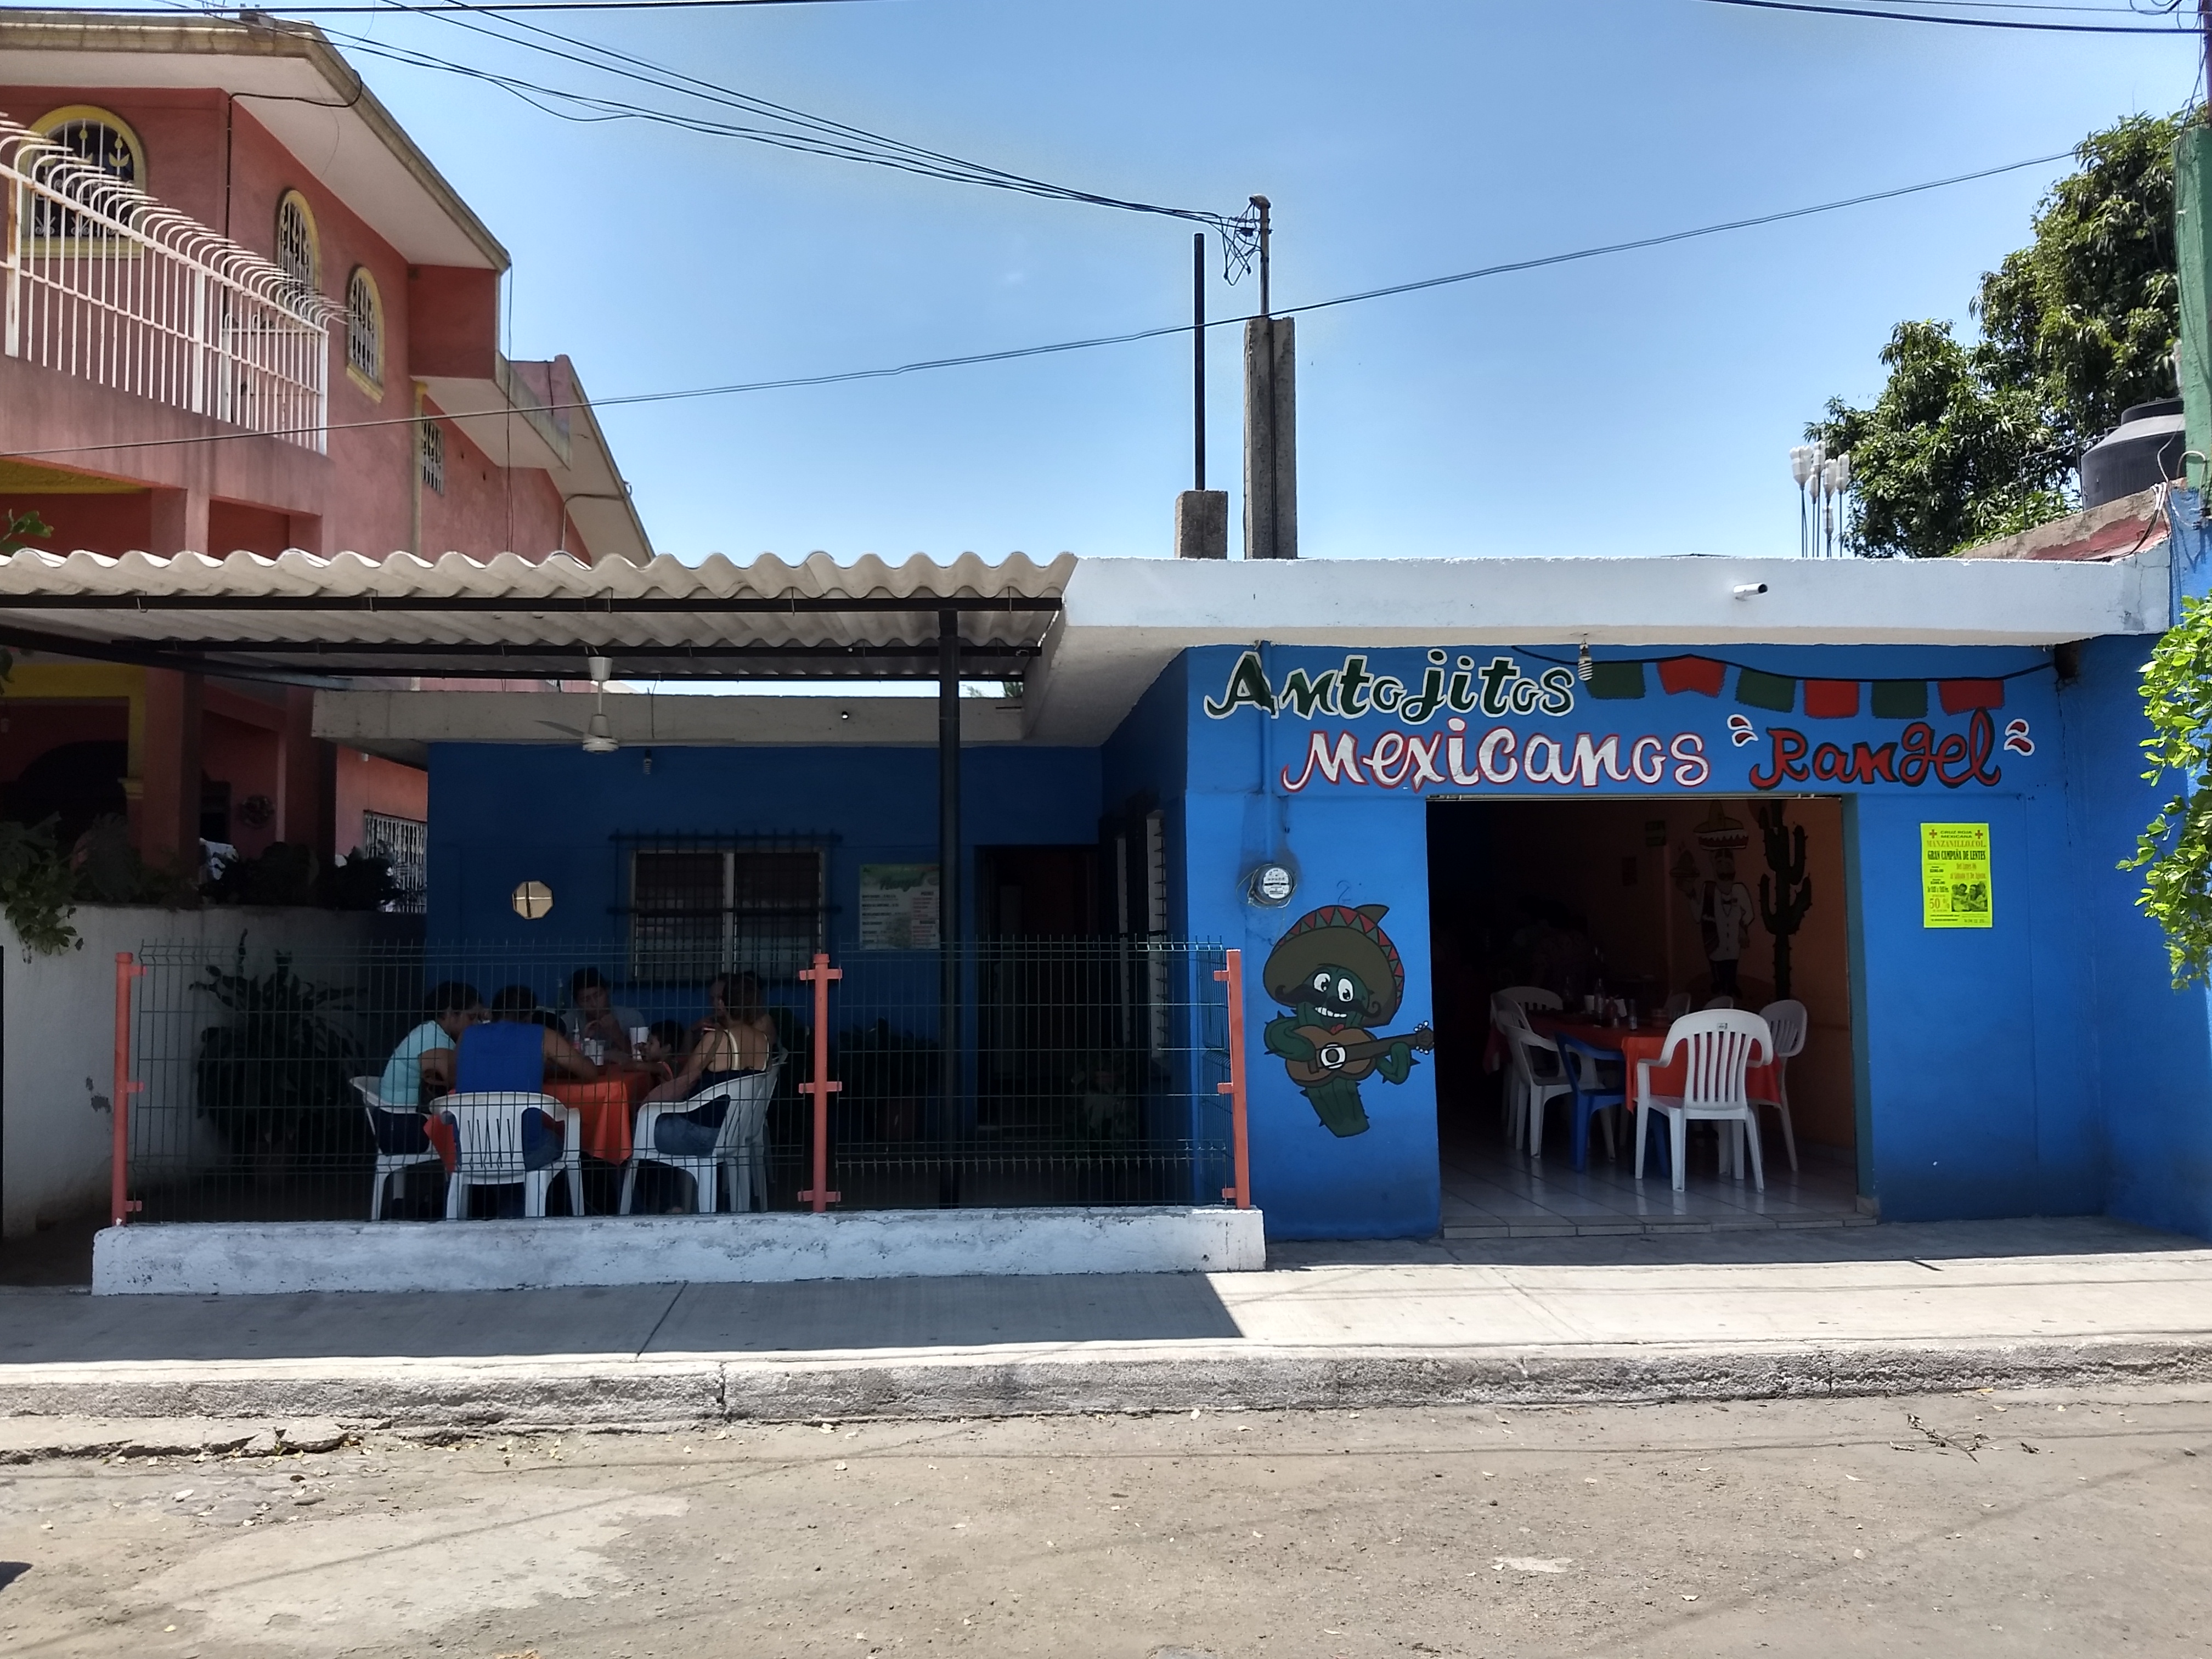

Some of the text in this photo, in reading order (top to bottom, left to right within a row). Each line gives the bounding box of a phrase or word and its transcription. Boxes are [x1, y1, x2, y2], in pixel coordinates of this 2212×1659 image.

[1204, 651, 1575, 725] Antojitos
[1280, 718, 1710, 792] Mexicanos
[1927, 850, 1940, 860] GRAN
[1962, 850, 1969, 860] DE
[1970, 850, 1986, 860] LENTES
[1929, 898, 1940, 909] 50
